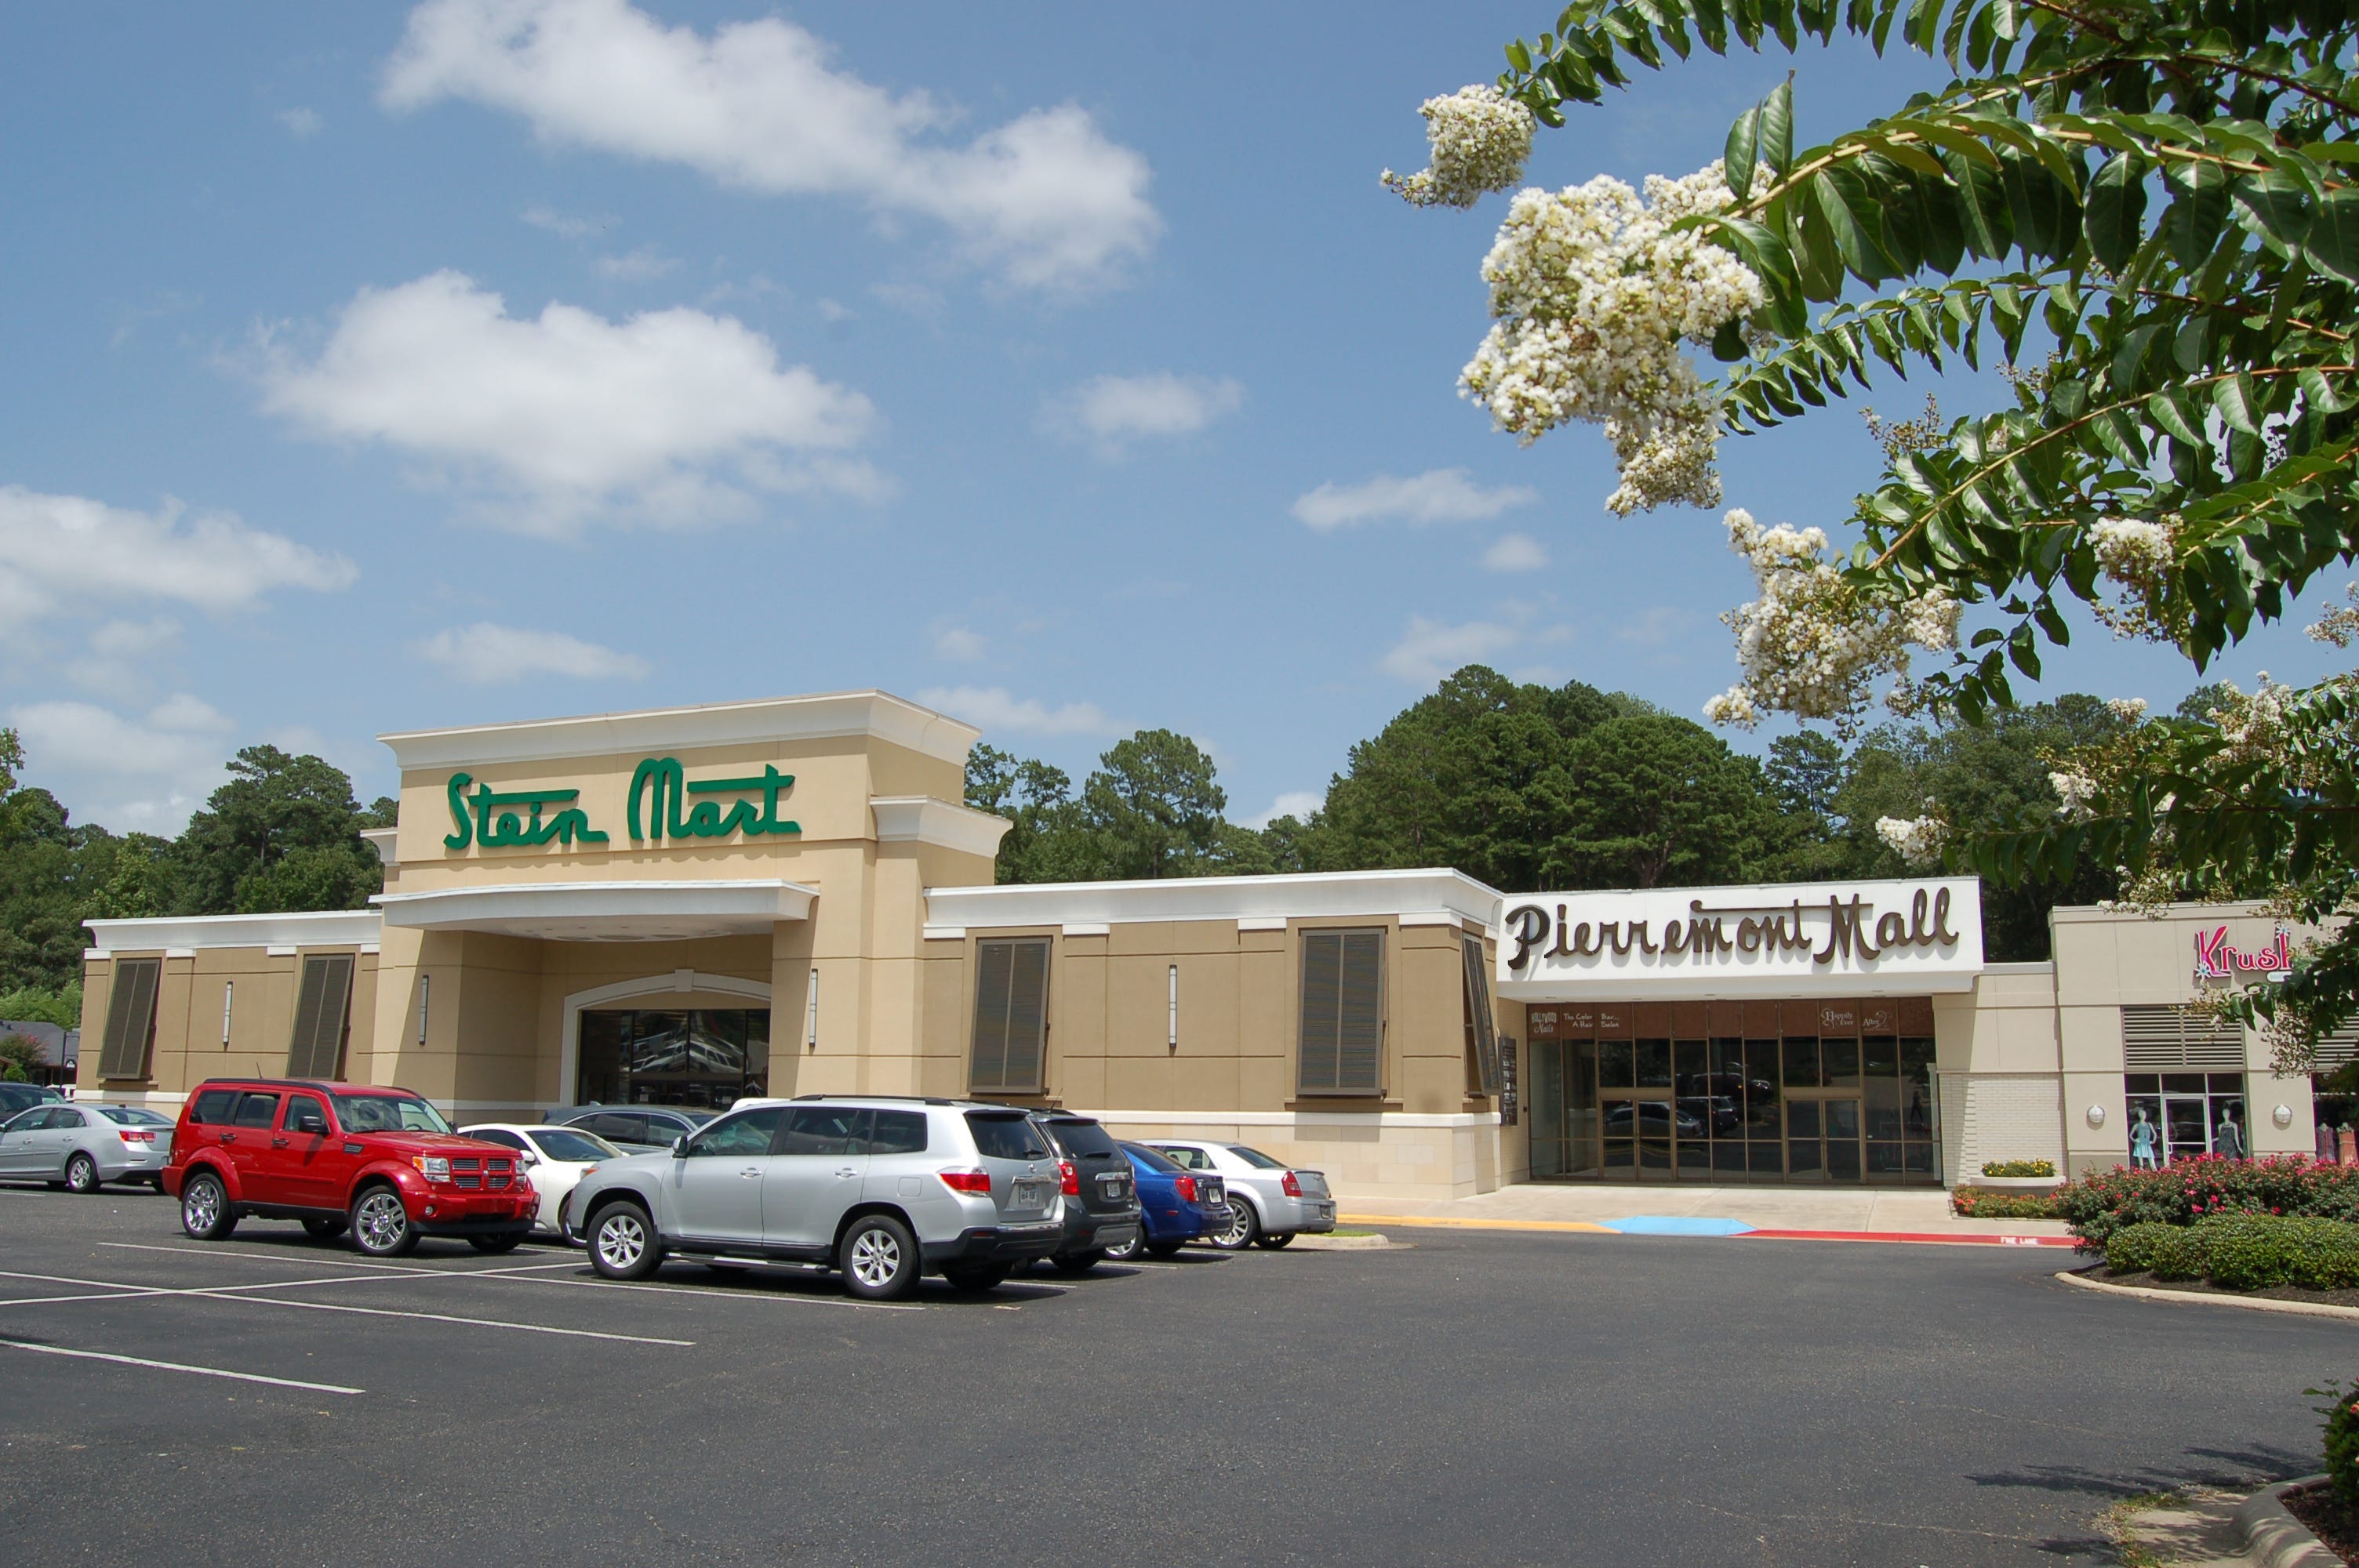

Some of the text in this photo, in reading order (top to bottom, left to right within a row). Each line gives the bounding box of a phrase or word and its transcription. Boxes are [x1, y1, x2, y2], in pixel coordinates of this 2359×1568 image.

[443, 757, 802, 850] Stein Mart
[1504, 887, 1959, 971] Pierremont Mall
